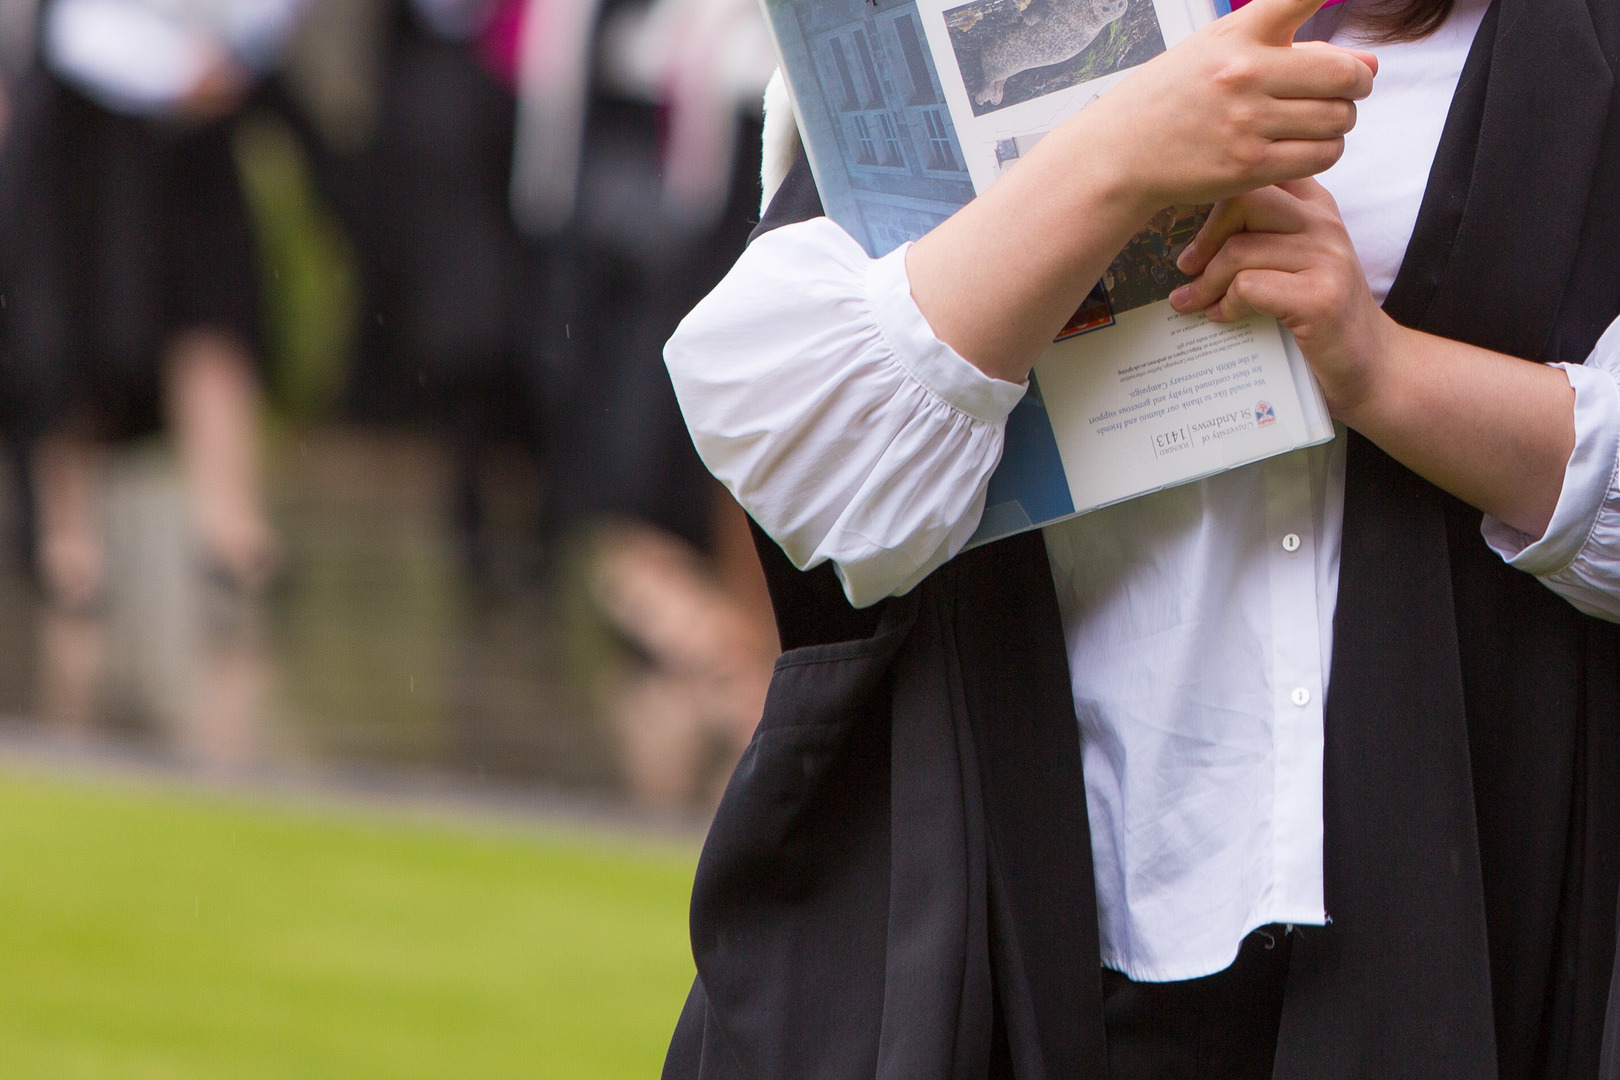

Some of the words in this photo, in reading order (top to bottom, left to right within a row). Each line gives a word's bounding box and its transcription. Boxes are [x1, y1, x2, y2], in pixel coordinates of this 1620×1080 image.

[1238, 356, 1250, 365] the
[1251, 353, 1259, 362] of
[1216, 360, 1237, 373] 600th
[1168, 367, 1214, 385] Anniversary
[1232, 369, 1250, 379] their
[1194, 375, 1231, 393] continued
[1229, 382, 1251, 395] would
[1254, 378, 1265, 386] We
[1129, 382, 1168, 396] Campaign.
[1168, 387, 1193, 399] loyalty
[1214, 390, 1228, 399] like
[1118, 398, 1151, 415] generous
[1153, 396, 1166, 406] and
[1181, 397, 1203, 410] thank
[1088, 411, 1117, 424] support
[1139, 409, 1165, 422] alumni
[1241, 408, 1252, 419] St
[1096, 422, 1122, 435] friends
[1123, 417, 1137, 428] and
[1191, 412, 1239, 432] Andrews
[1211, 422, 1254, 438] University
[1156, 428, 1186, 448] 1413
[1201, 435, 1210, 444] of
[1159, 442, 1189, 456] FOUNDED
